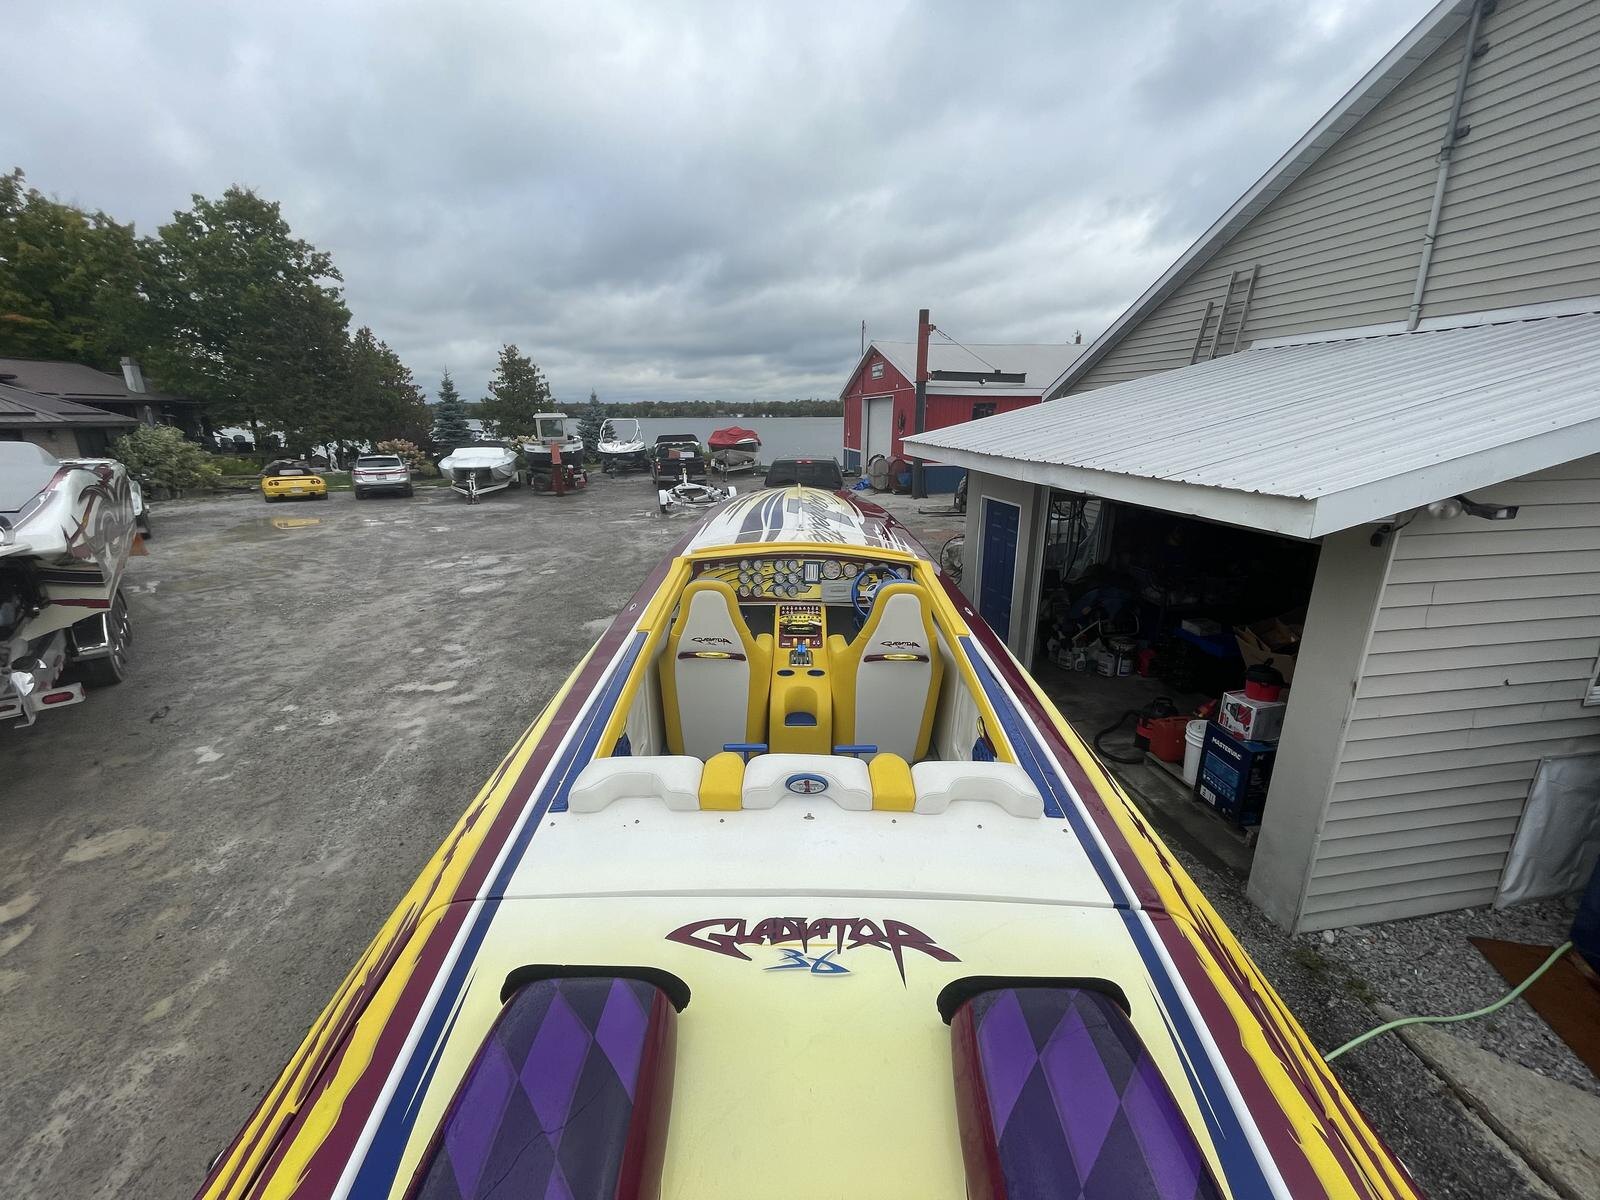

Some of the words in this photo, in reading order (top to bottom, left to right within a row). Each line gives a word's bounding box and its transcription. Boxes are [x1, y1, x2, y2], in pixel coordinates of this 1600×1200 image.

[1211, 736, 1243, 761] MASTERVAC
[664, 917, 962, 990] GLADIATOR
[761, 948, 852, 975] 36
